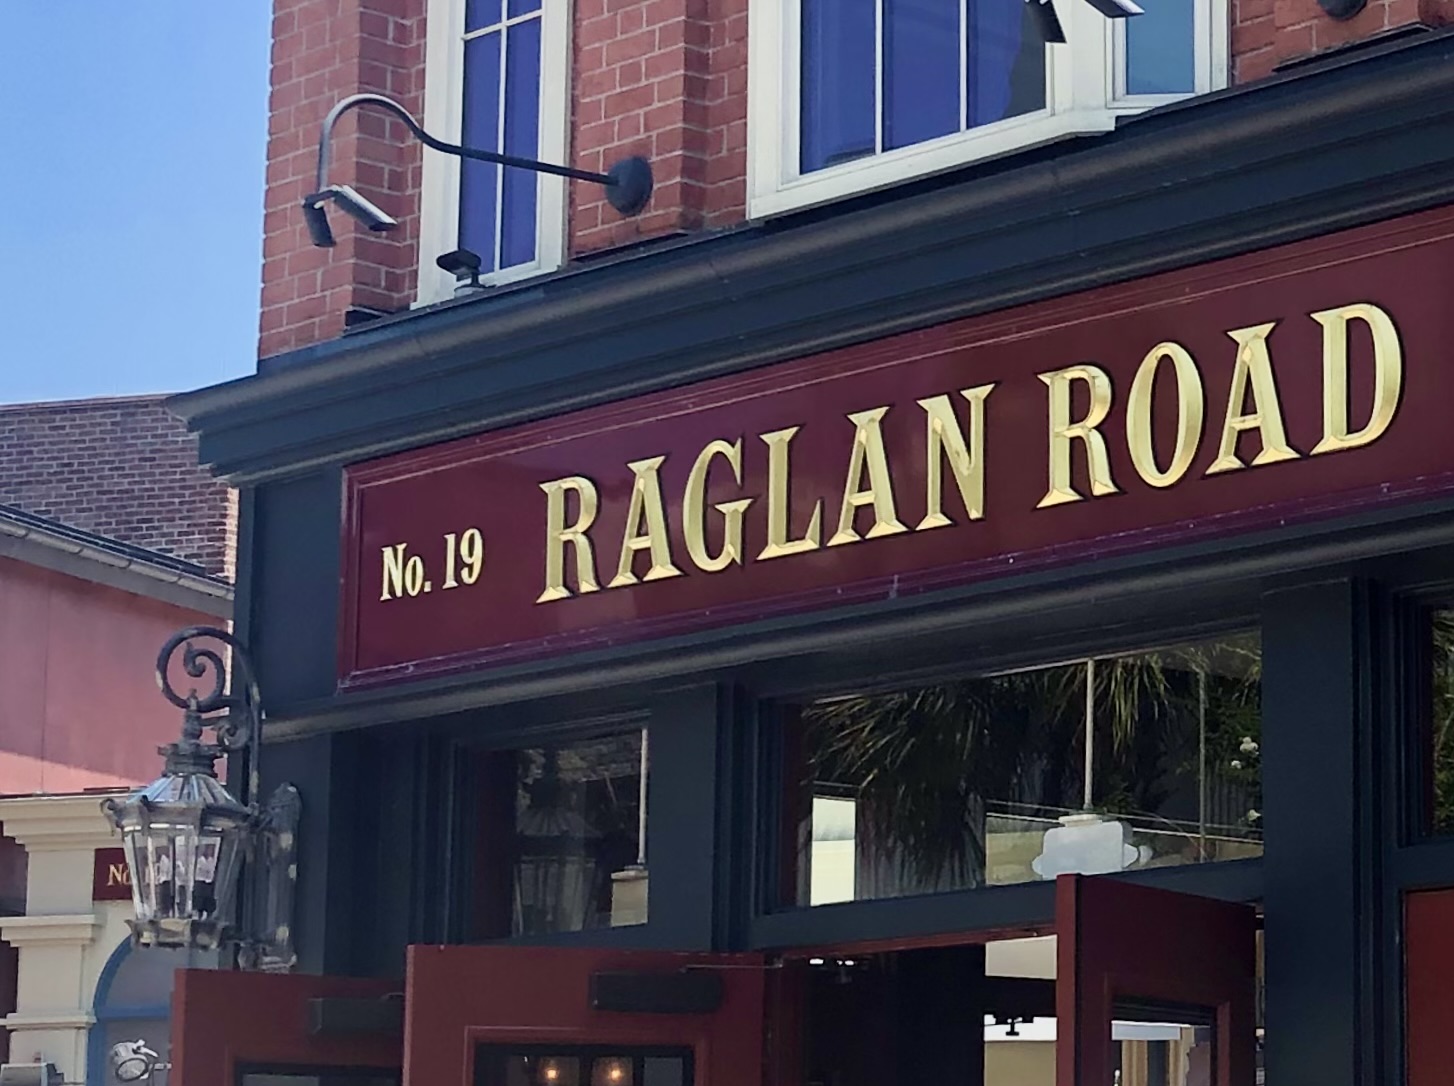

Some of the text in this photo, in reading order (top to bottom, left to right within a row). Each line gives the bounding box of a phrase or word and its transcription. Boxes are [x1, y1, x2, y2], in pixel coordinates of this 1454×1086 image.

[380, 542, 432, 601] No.
[442, 528, 483, 590] 19
[536, 383, 995, 604] RAGLAN
[1036, 303, 1403, 508] ROAD
